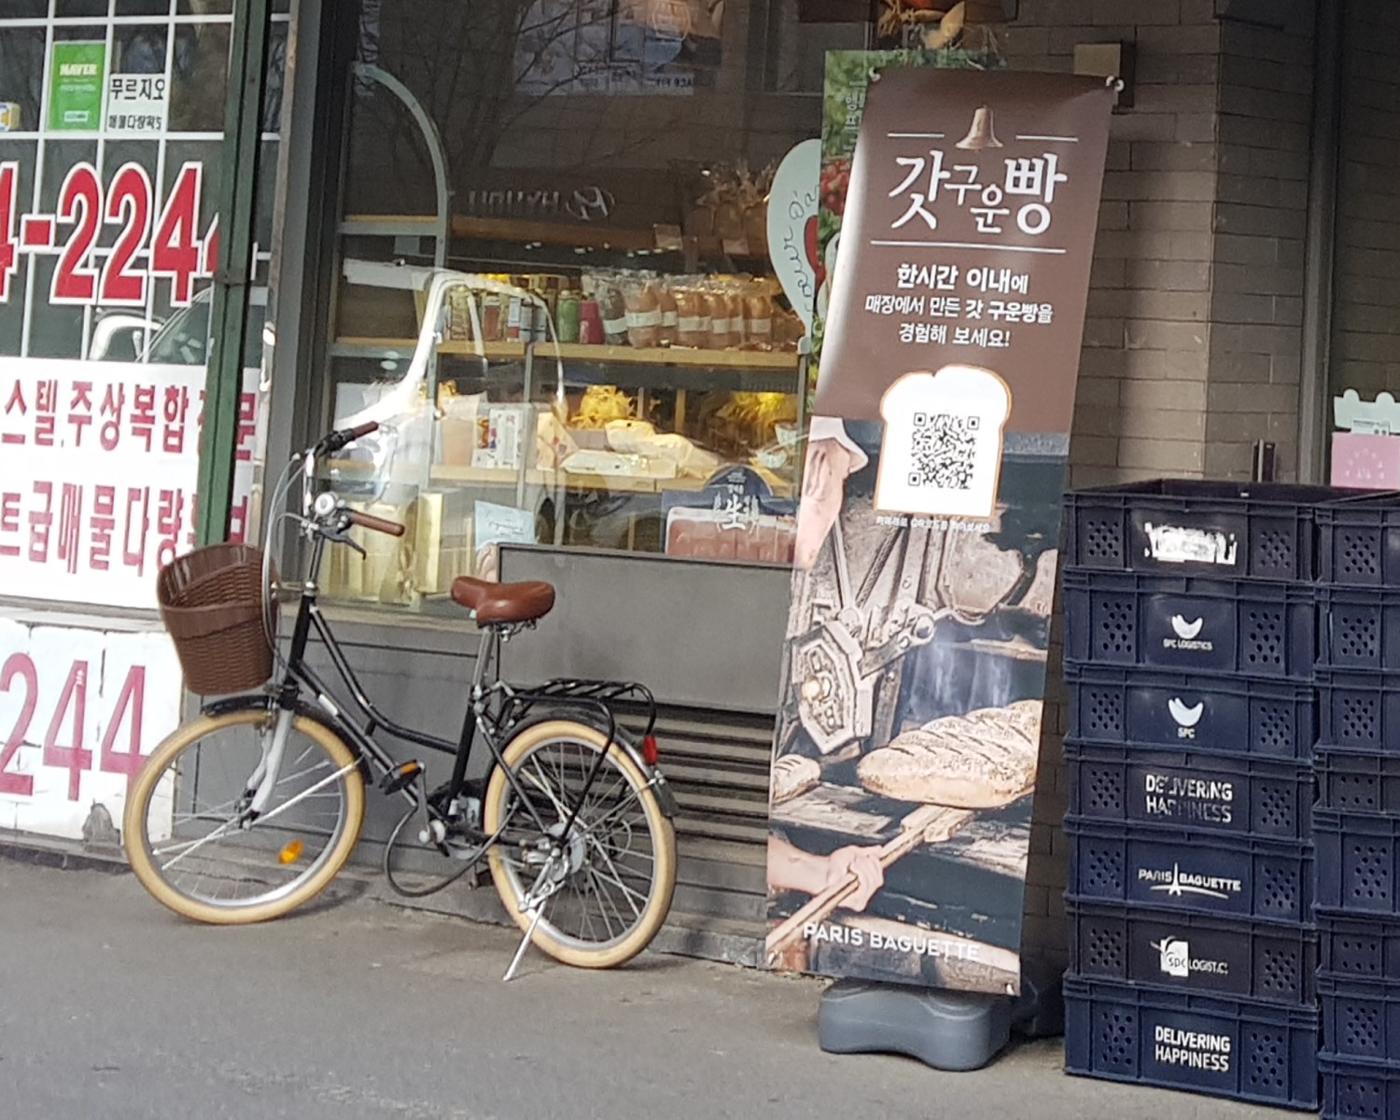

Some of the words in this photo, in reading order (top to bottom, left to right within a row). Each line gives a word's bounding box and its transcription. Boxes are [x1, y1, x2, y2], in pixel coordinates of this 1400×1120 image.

[897, 264, 958, 291] 한시간
[966, 267, 1029, 294] 이내에
[865, 294, 925, 316] 매장에서
[930, 296, 961, 318] 만든
[965, 300, 984, 320] 갓
[988, 301, 1054, 324] 구운빵을
[898, 323, 947, 345] 경험해
[953, 327, 1010, 348] 보세요!
[1138, 868, 1172, 882] PARIS
[1179, 872, 1241, 892] BAGUETTE
[803, 922, 863, 946] PARIS
[870, 929, 980, 961] BAGUETTE
[1155, 1025, 1230, 1052] DELIVERING
[1155, 1045, 1229, 1072] HAPPINESS
